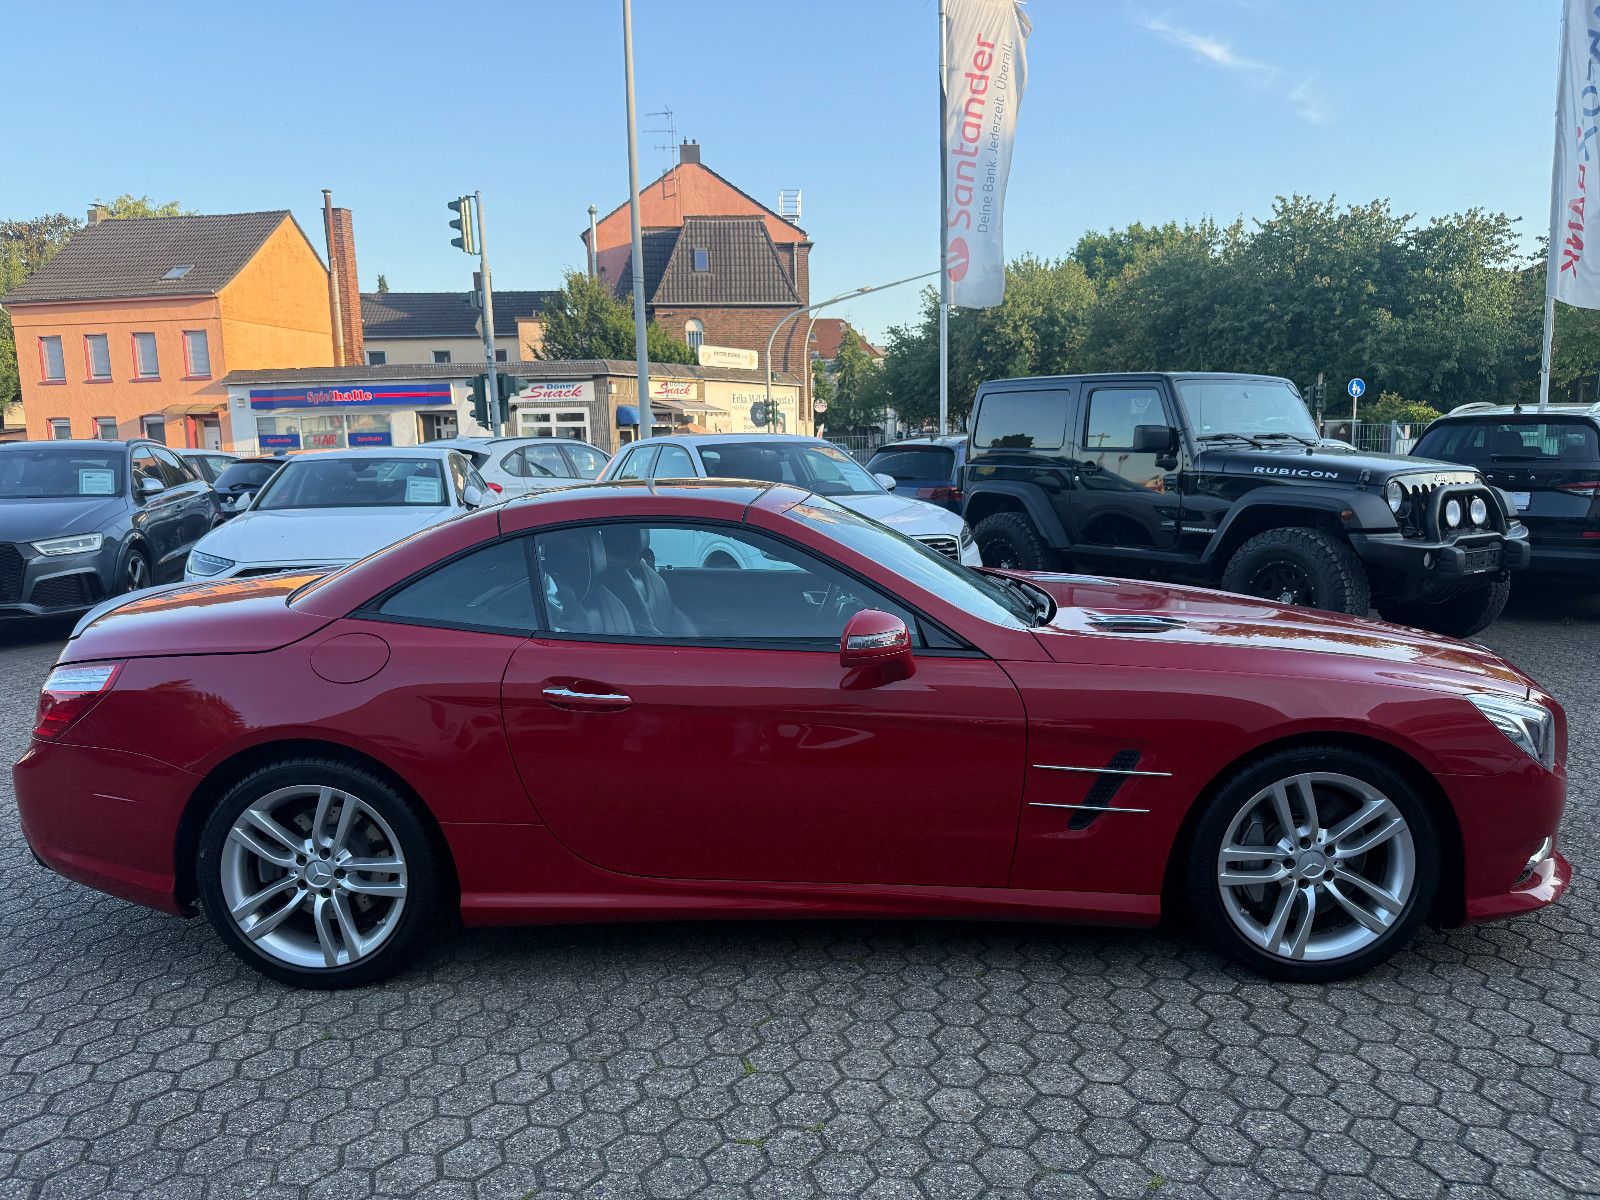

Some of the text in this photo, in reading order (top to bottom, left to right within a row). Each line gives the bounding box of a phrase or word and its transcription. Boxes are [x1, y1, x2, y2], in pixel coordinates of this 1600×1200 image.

[947, 32, 995, 230] Santander
[977, 41, 1014, 233] Deine Bank. Jederzeit. Überall.
[520, 385, 583, 398] Snack
[654, 382, 691, 395] Snack
[1253, 466, 1339, 479] RUBICON
